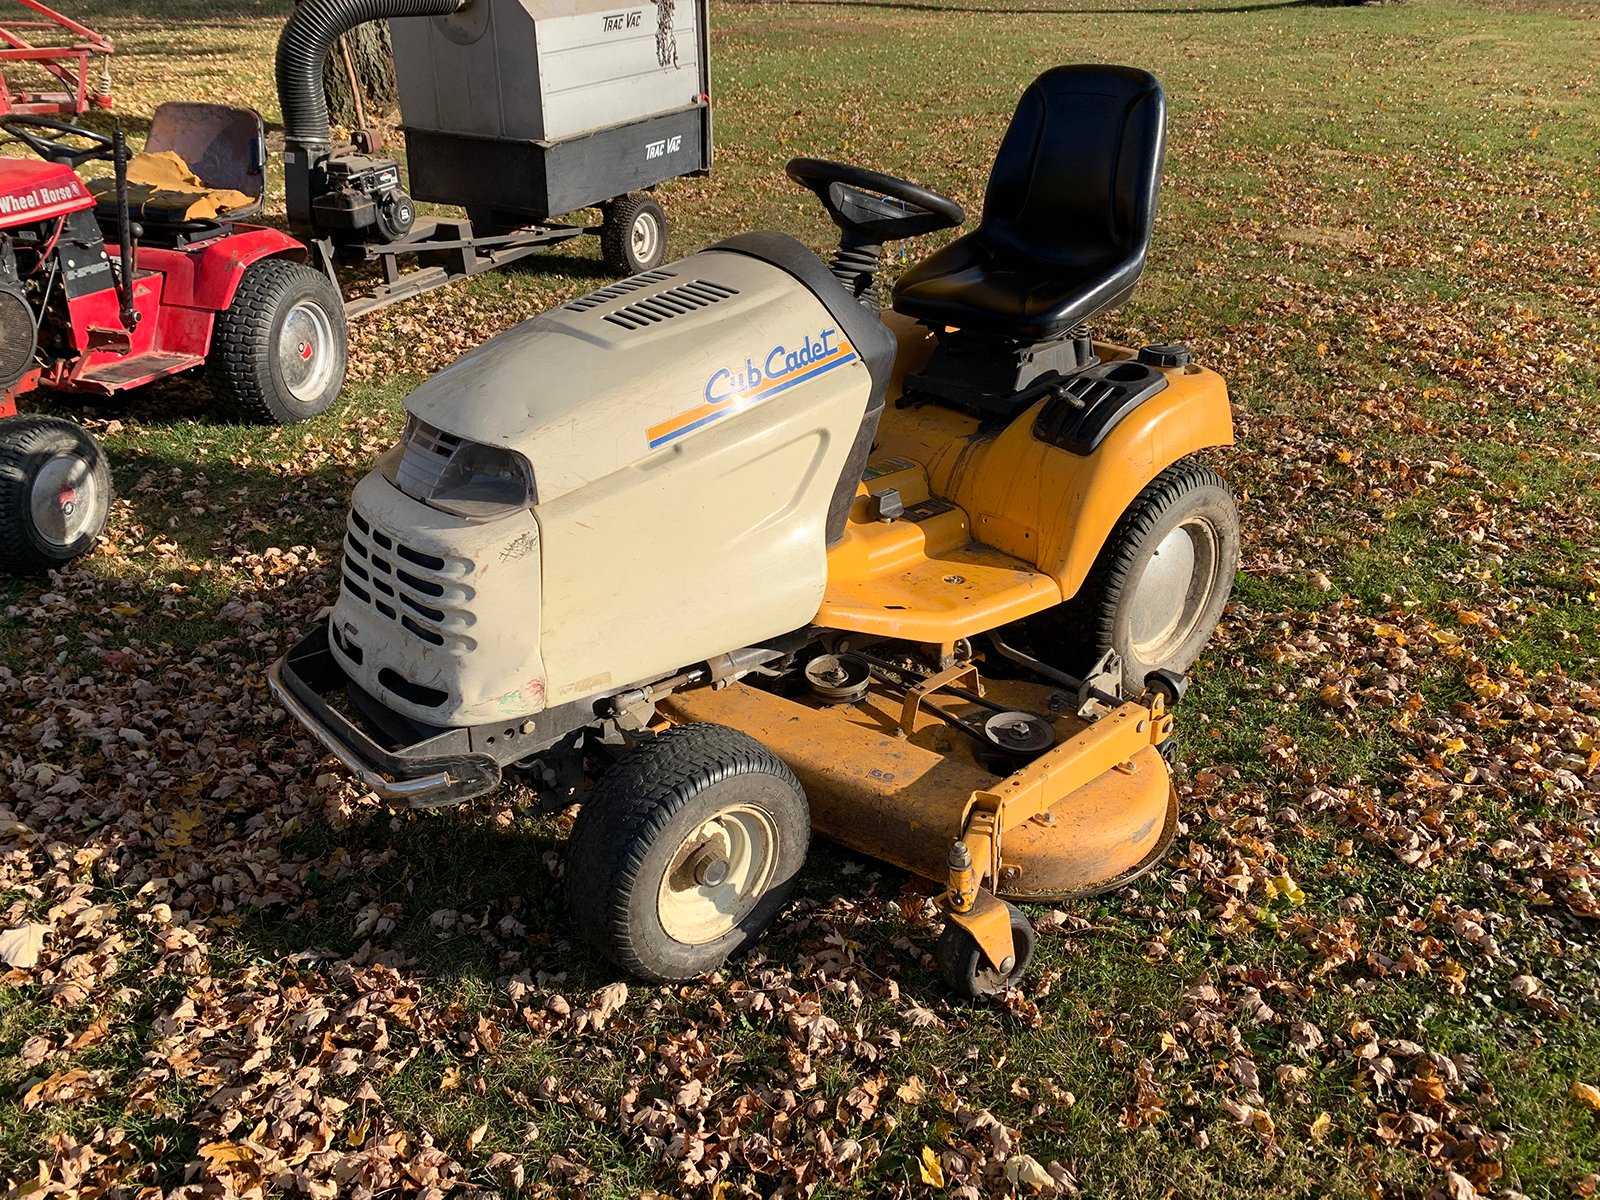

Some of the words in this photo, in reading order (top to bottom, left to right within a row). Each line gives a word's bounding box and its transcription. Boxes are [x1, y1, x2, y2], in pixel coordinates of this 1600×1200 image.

[603, 14, 624, 32] TRAC
[626, 11, 642, 29] VAC
[645, 140, 665, 160] TRAC
[667, 135, 682, 154] VAC
[0, 190, 40, 214] Wheel
[40, 186, 72, 204] Horse
[705, 358, 762, 404] Cub
[764, 328, 838, 379] Cadet
